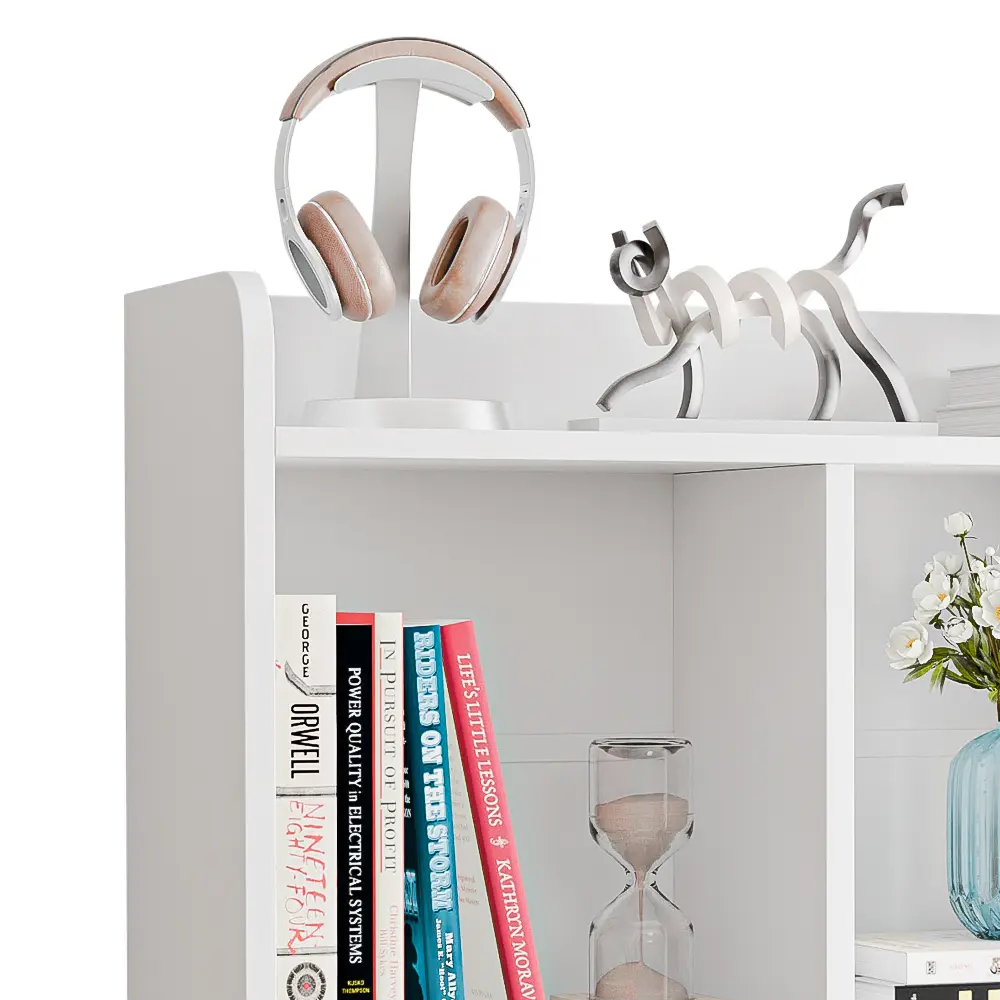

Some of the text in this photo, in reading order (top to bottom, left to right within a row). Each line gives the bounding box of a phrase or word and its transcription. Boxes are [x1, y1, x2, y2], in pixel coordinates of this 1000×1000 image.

[301, 603, 310, 678] GEORGE
[457, 653, 480, 701] LIFE'S
[290, 703, 320, 779] ORWELL
[379, 640, 397, 873] IN PURSUIT OF PROFIT
[466, 700, 490, 756] LITTLE
[413, 631, 454, 913] RIDERS ON THE STORM
[477, 756, 503, 827] LESSONS
[345, 667, 363, 965] POWER QUALITY in ELECTRICAL SYSTEMS
[285, 800, 307, 955] EIGHTY-FOUR
[302, 803, 327, 940] NINETEEN
[496, 858, 524, 940] KATHRYN
[435, 918, 443, 948] James
[445, 932, 455, 970] Mary
